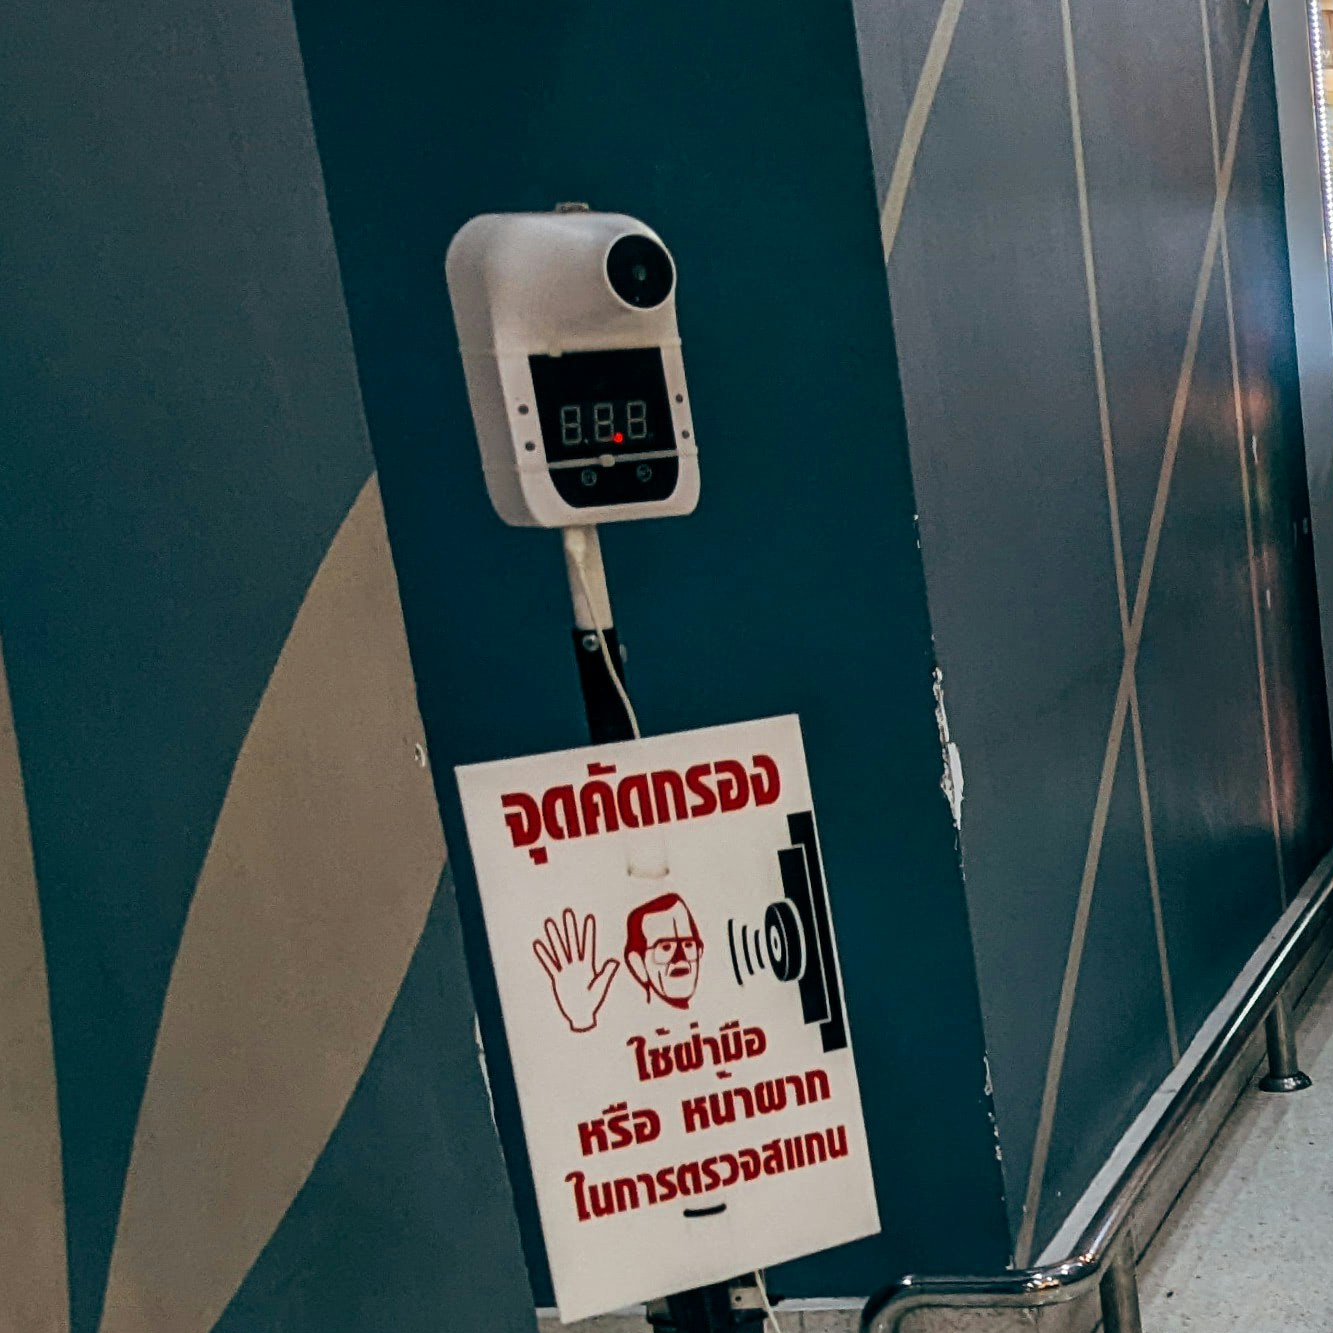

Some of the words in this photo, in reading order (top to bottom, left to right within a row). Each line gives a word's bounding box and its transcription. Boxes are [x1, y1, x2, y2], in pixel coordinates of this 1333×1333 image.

[501, 753, 783, 865] จุดคัดกรอง
[626, 1020, 767, 1082] ใช้ฝ่ามือ
[577, 1101, 662, 1157] หรือ
[681, 1068, 831, 1134] หน้าผาก
[565, 1125, 849, 1222] ในการตรวจสแกน
